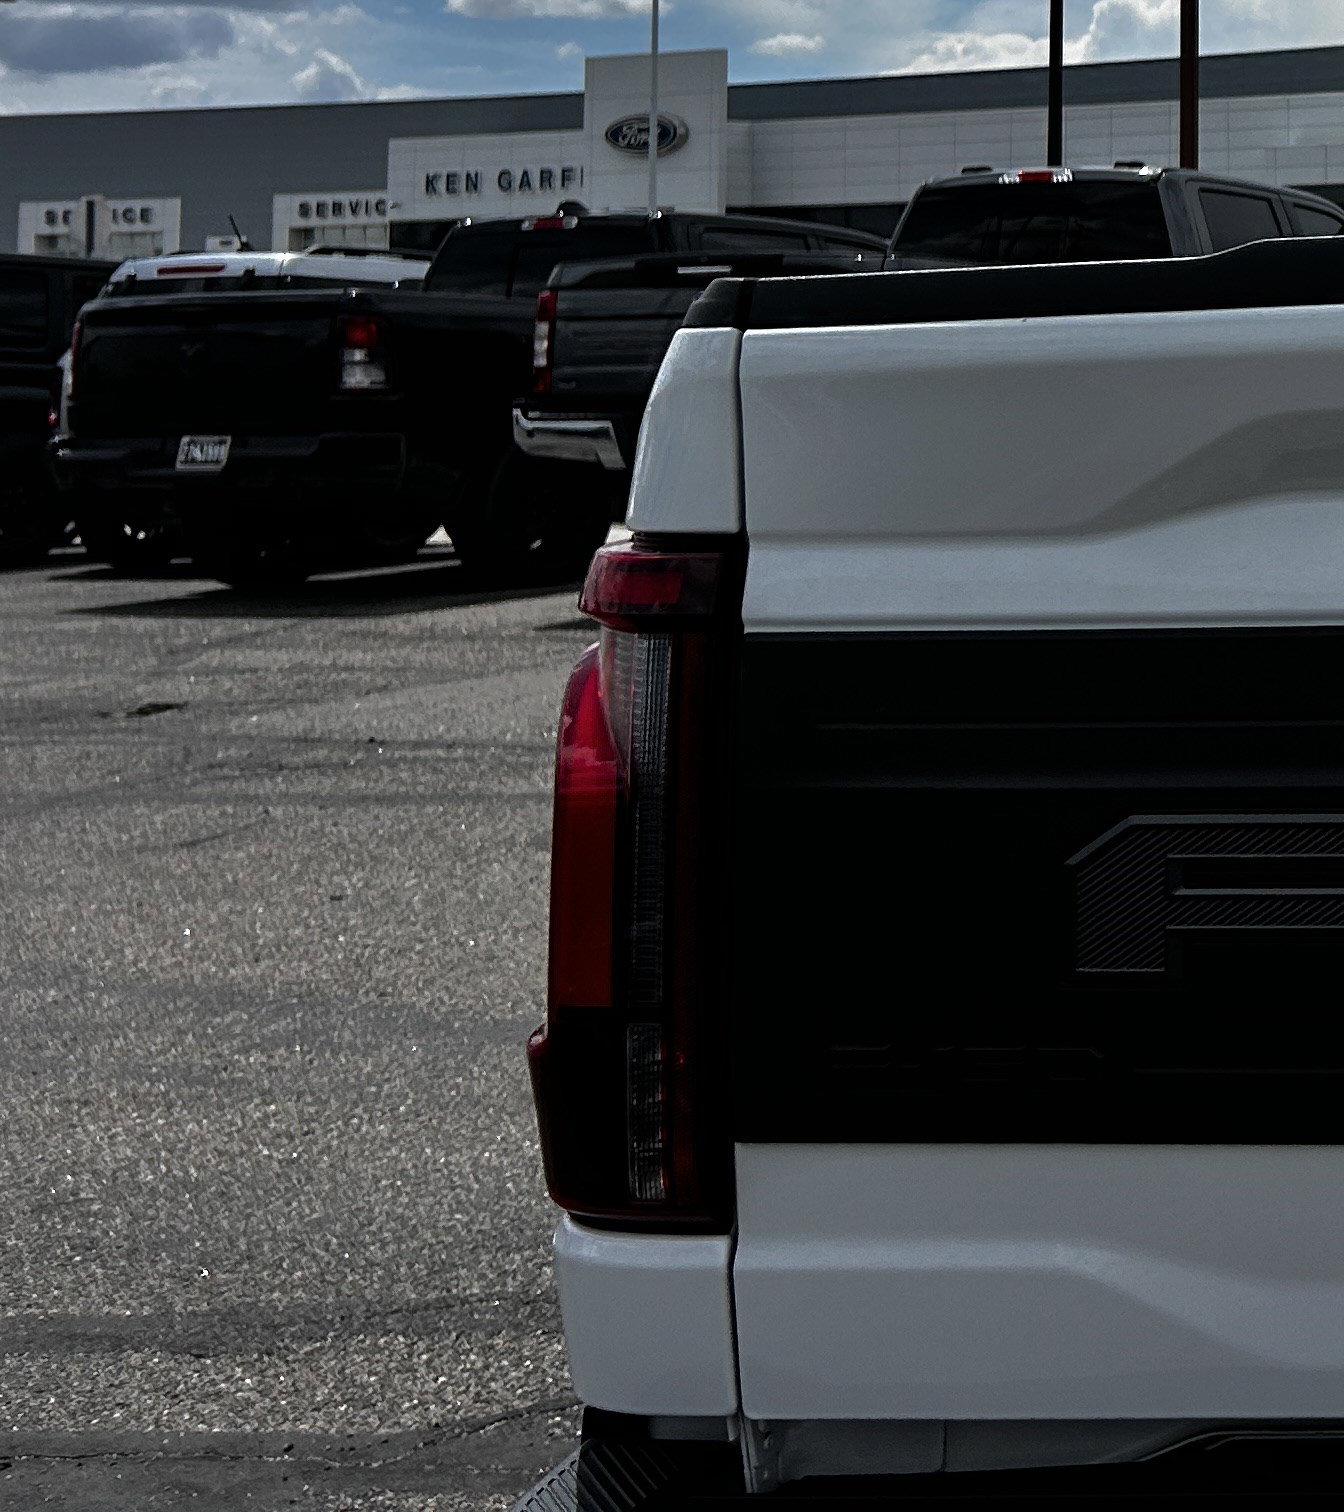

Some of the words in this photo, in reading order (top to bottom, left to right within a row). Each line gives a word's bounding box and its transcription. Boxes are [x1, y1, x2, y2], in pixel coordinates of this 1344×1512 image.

[425, 170, 479, 196] KEN
[44, 207, 153, 226] SEICE
[298, 199, 389, 219] SERVIC
